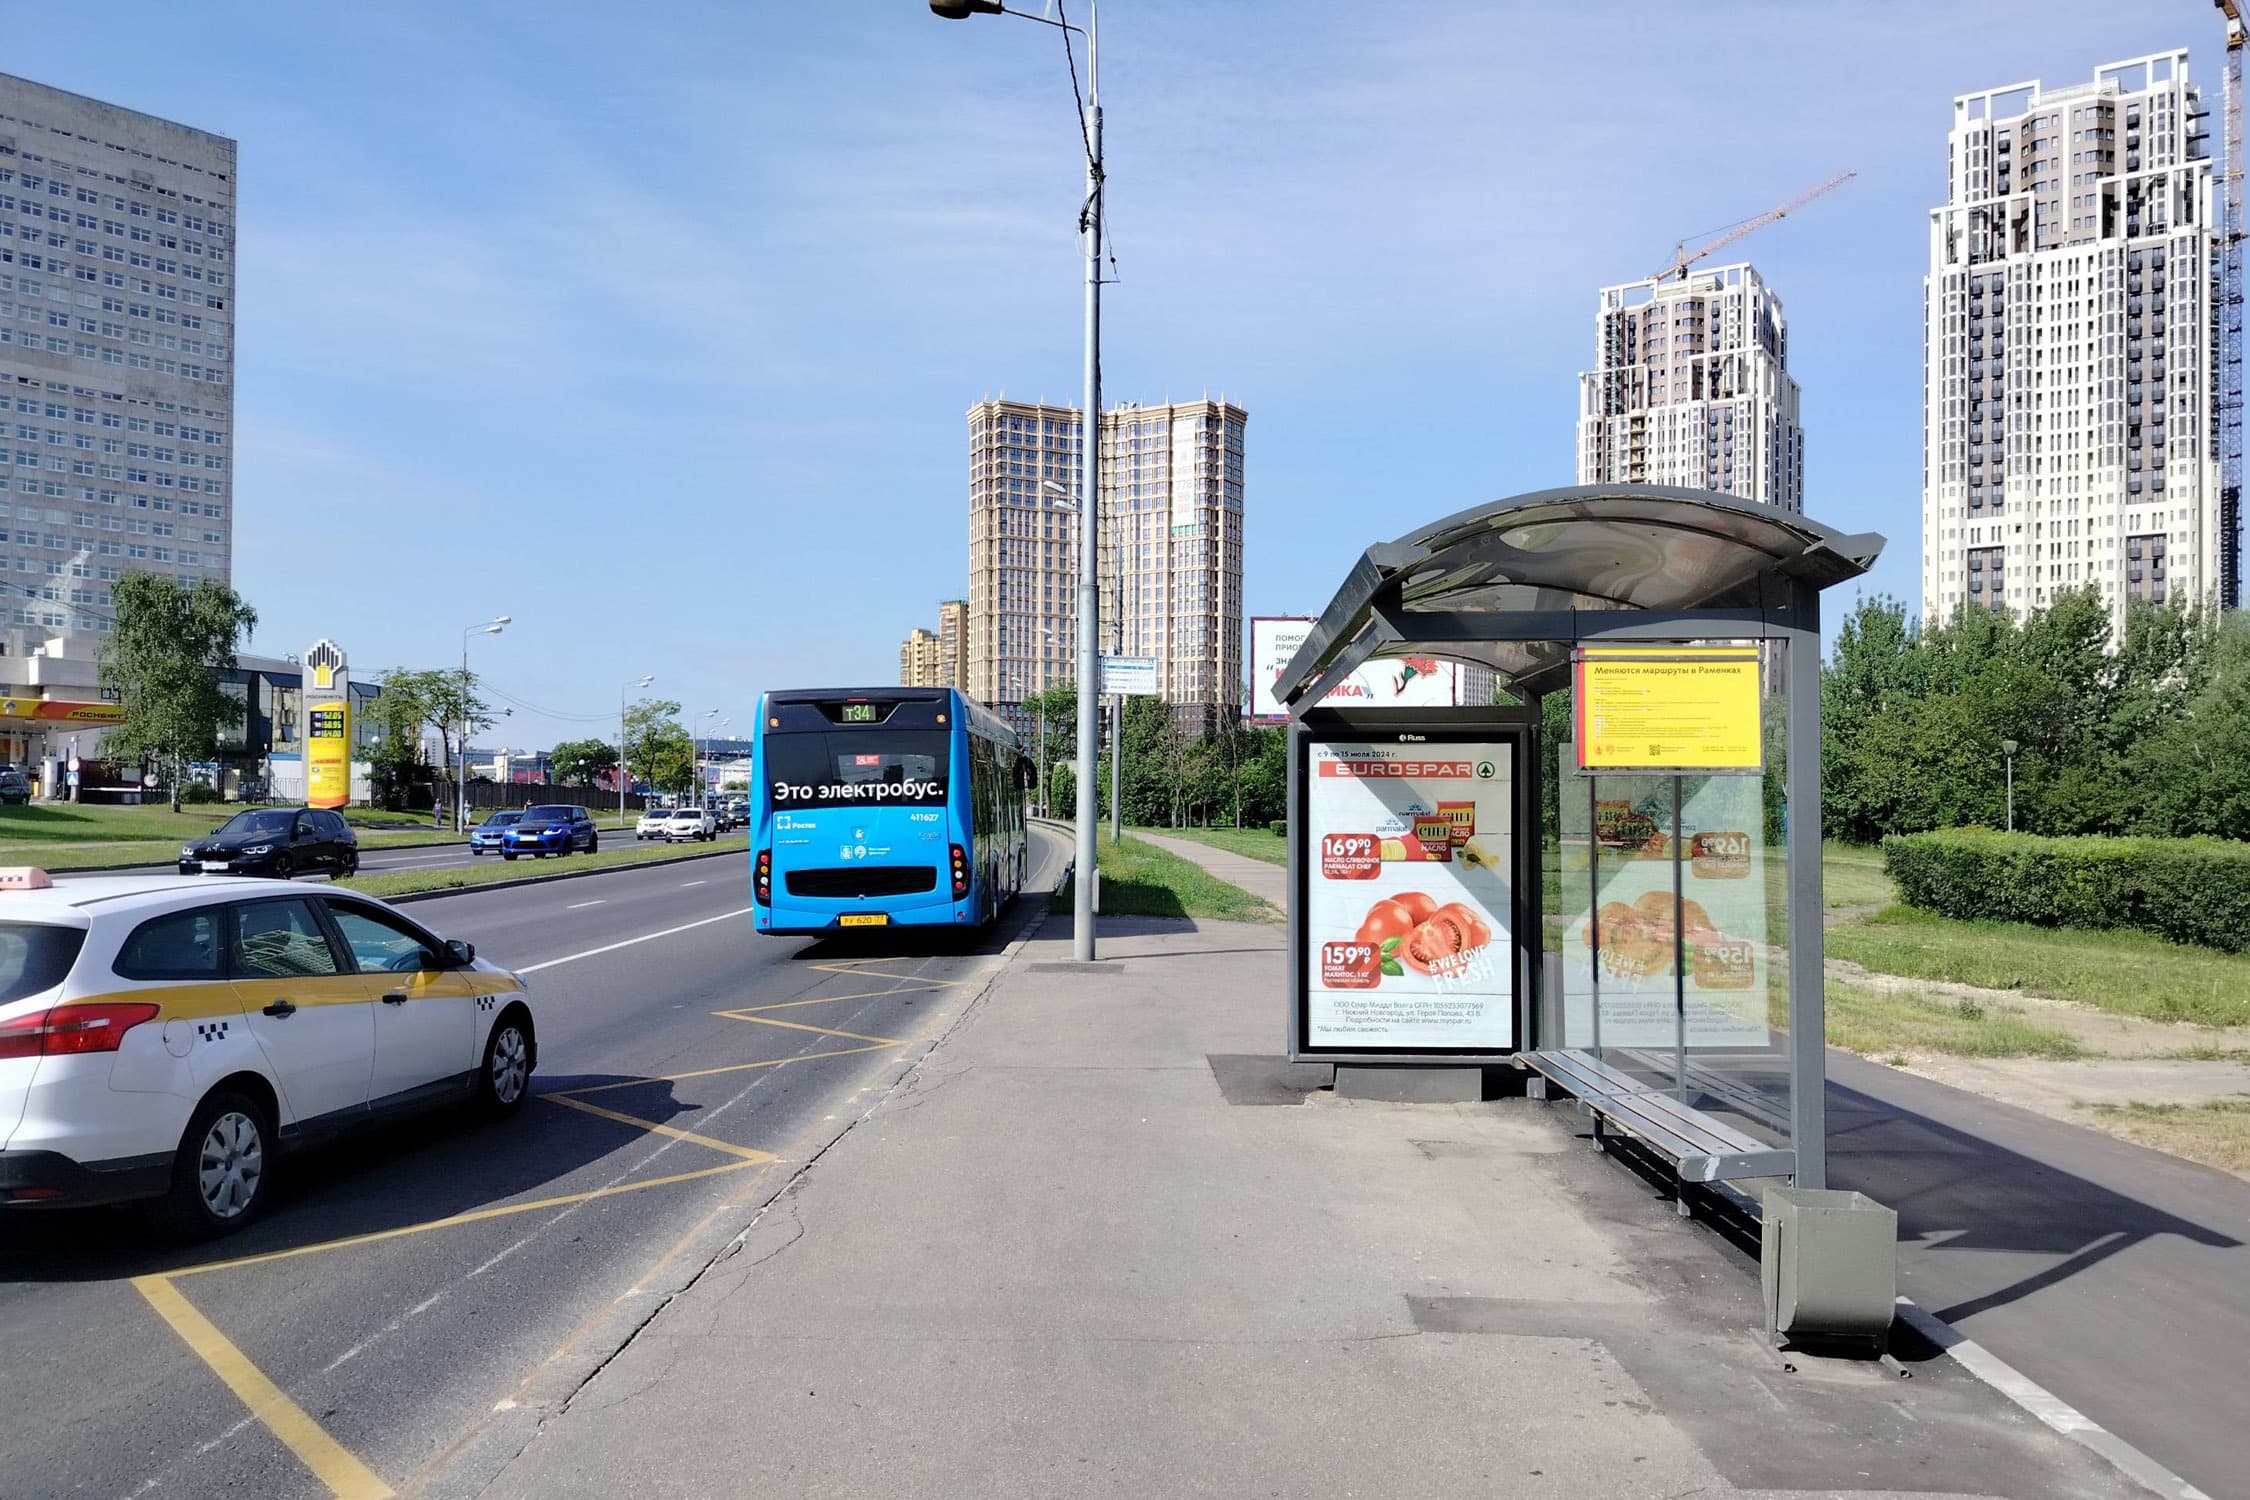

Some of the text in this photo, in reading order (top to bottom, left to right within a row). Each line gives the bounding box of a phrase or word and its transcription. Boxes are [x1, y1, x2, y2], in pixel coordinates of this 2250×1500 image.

[1594, 667, 1641, 675] Меняются
[1642, 668, 1689, 676] маршруты
[1698, 666, 1742, 674] Раменках
[1335, 763, 1472, 775] EUROSPAR
[774, 778, 944, 801] Это электробус.
[910, 813, 939, 822] 411627
[1324, 838, 1358, 856] 169
[1358, 838, 1371, 848] 90
[1421, 844, 1447, 852] МАСЛО
[856, 916, 872, 924] 620
[1324, 946, 1358, 964] 159
[1358, 946, 1371, 956] 90
[1428, 944, 1488, 974] #WE LOVE
[1431, 956, 1496, 994] FRESH
